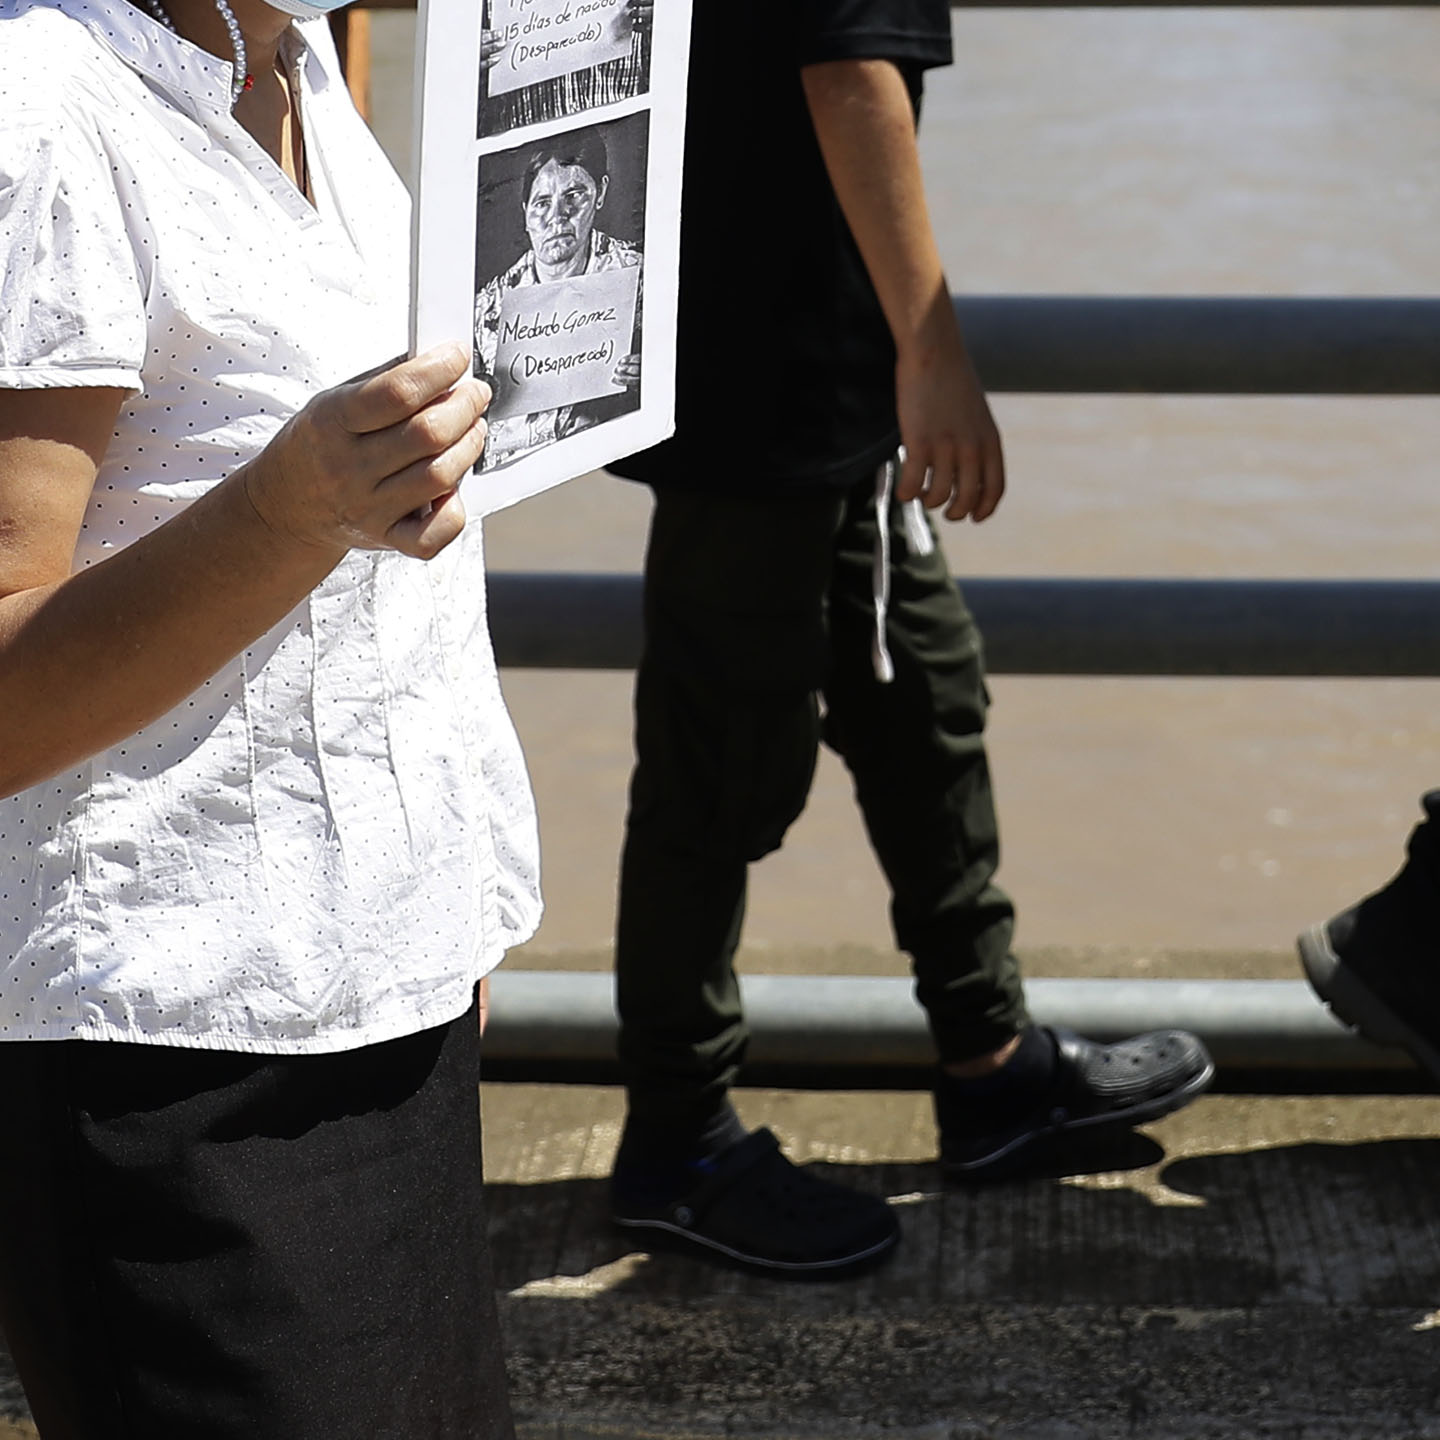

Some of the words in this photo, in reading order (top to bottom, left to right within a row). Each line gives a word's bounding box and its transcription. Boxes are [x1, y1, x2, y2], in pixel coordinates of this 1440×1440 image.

[504, 22, 520, 42] 15
[522, 11, 551, 35] días
[555, 1, 572, 25] de
